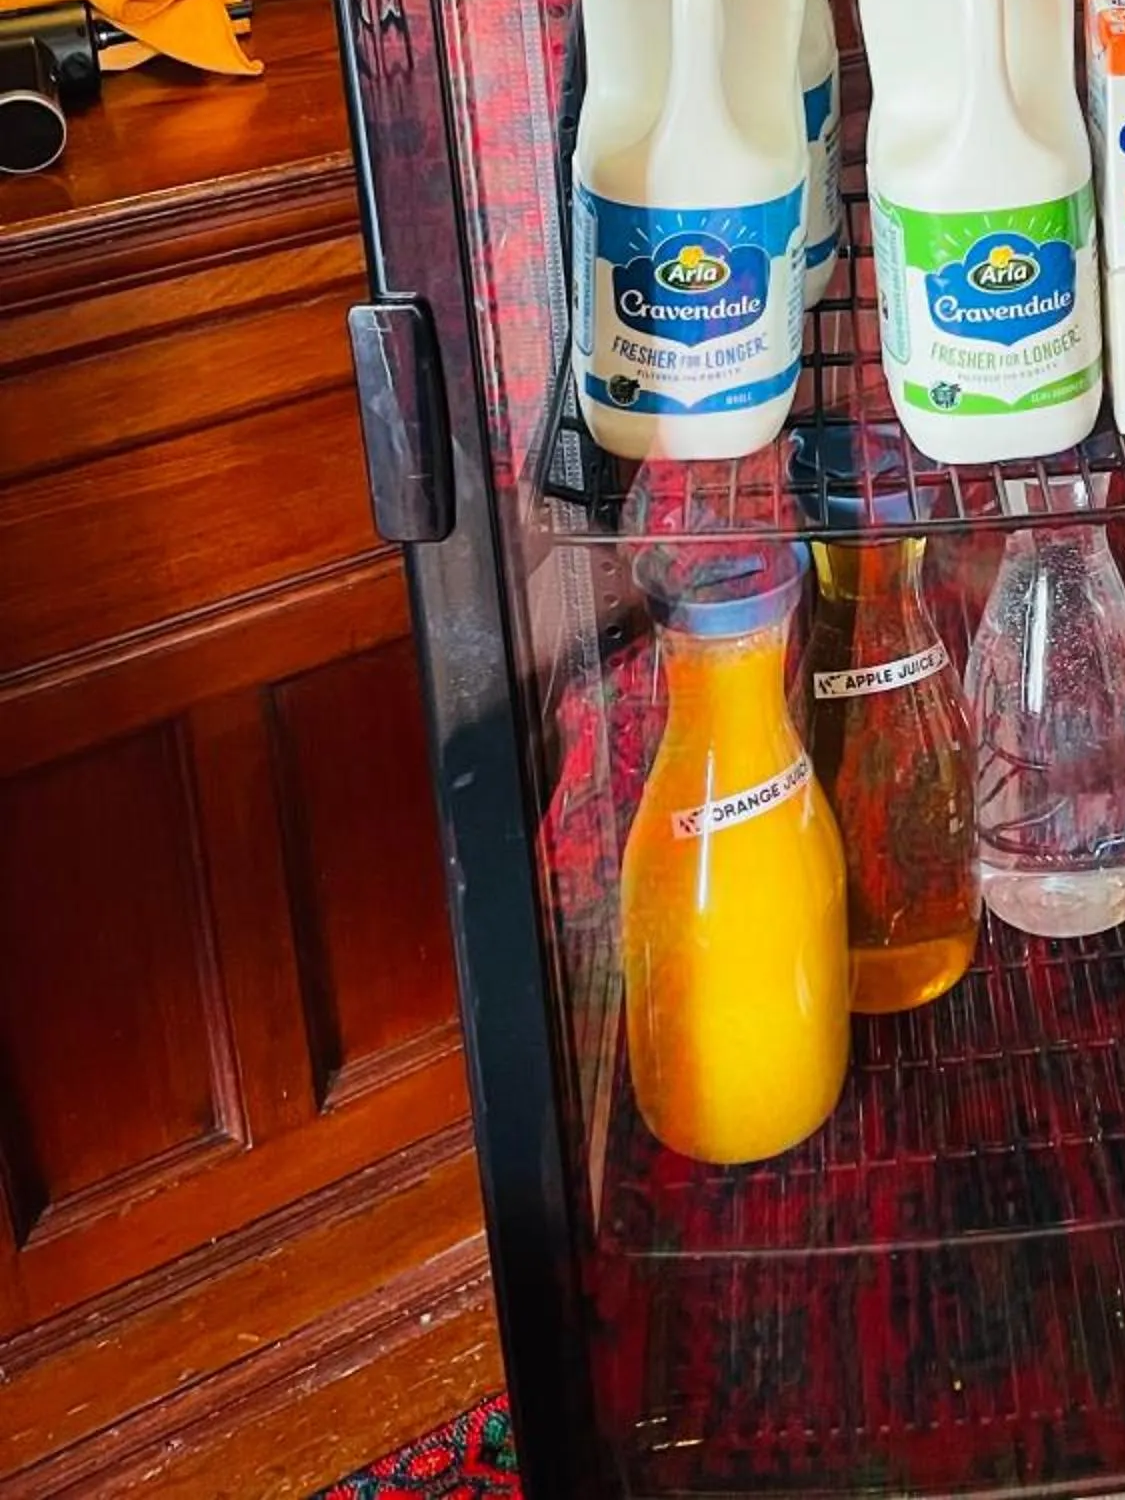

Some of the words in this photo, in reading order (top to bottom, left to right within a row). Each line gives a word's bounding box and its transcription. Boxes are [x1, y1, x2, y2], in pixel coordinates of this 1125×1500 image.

[668, 262, 718, 283] Arla
[979, 262, 1027, 284] Arla
[620, 289, 762, 321] Cravendale
[934, 290, 1072, 323] Cravendale
[611, 335, 677, 369] FRESHER
[705, 336, 766, 369] LONGER
[930, 341, 995, 370] FRESHER
[845, 669, 893, 690] APPLE
[898, 654, 935, 679] JUICE
[712, 783, 781, 822] ORANGE
